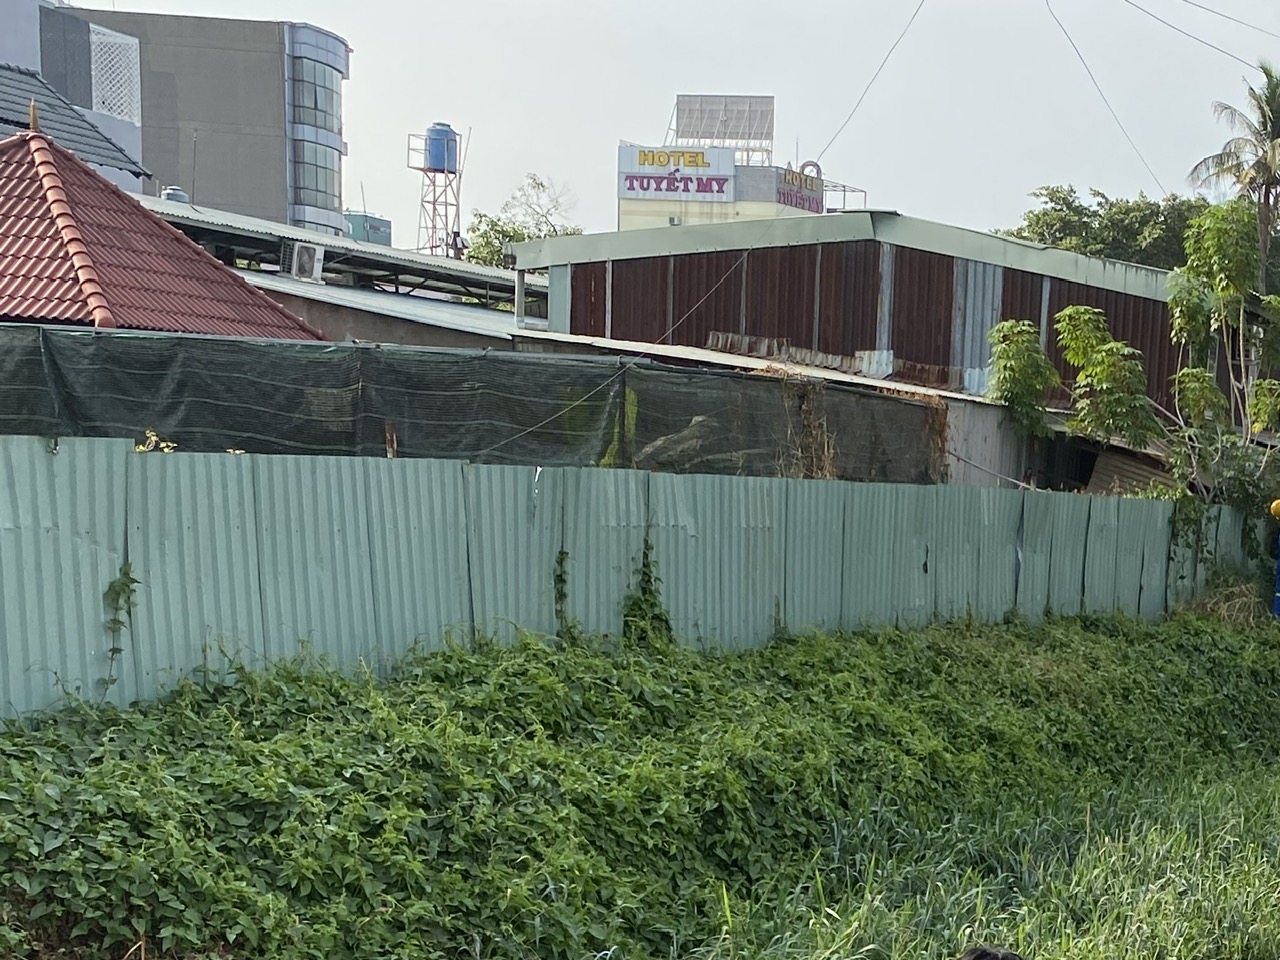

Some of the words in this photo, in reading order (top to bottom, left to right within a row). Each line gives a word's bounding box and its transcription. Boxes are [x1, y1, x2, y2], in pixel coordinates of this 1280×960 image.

[638, 150, 710, 168] HOTEL
[624, 168, 694, 192] TUYẾT
[695, 177, 729, 194] MY
[784, 169, 818, 192] HOTEL
